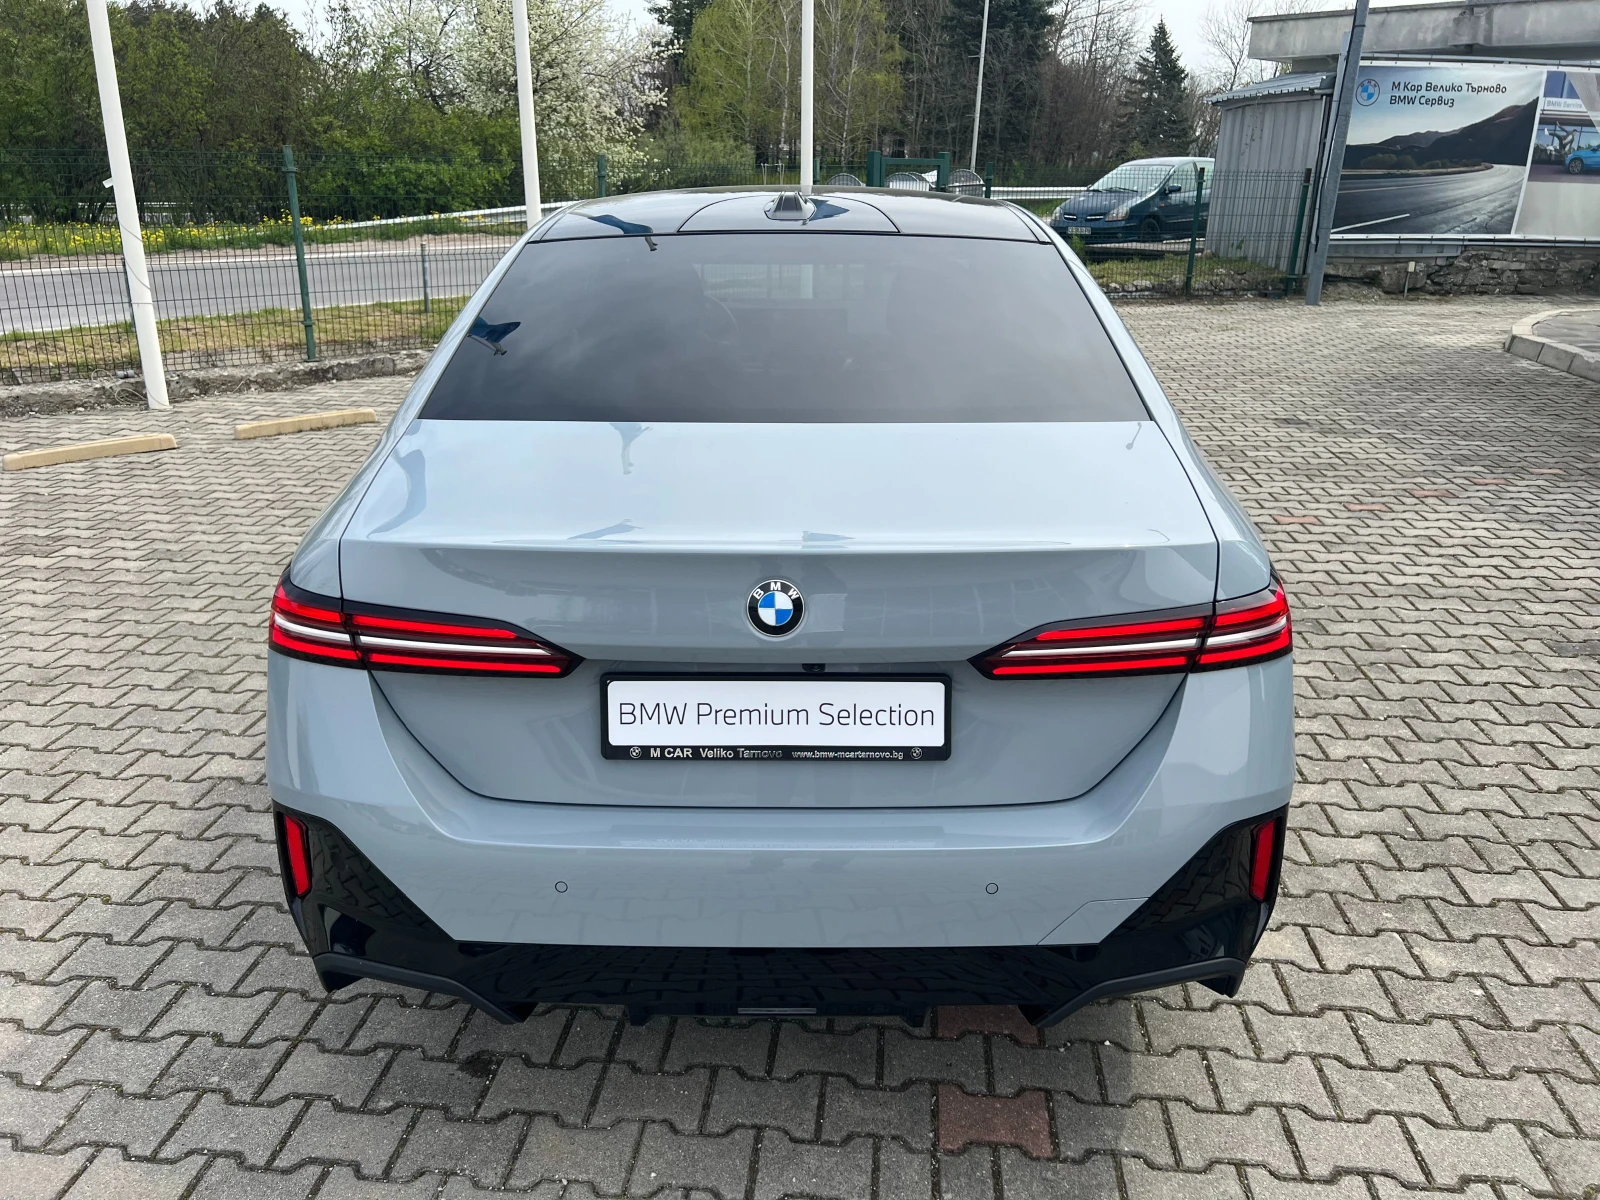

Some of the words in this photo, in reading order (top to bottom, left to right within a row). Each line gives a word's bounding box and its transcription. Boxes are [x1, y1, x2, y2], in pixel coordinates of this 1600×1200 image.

[1403, 81, 1423, 94] Кар
[1425, 82, 1463, 92] Велико
[1465, 82, 1507, 95] Търново
[1389, 95, 1417, 105] BMW
[1418, 95, 1455, 108] Сервиз
[1546, 100, 1562, 108] BMW
[753, 581, 799, 600] BMW
[619, 702, 687, 725] BMW
[697, 702, 810, 726] Premium
[819, 702, 935, 726] Selection
[650, 747, 661, 758] M
[664, 747, 693, 758] CAR
[700, 747, 734, 758] Veliko
[736, 747, 783, 758] Tarnovo
[791, 750, 904, 760] www.bmw-mcartarnovo.bg
